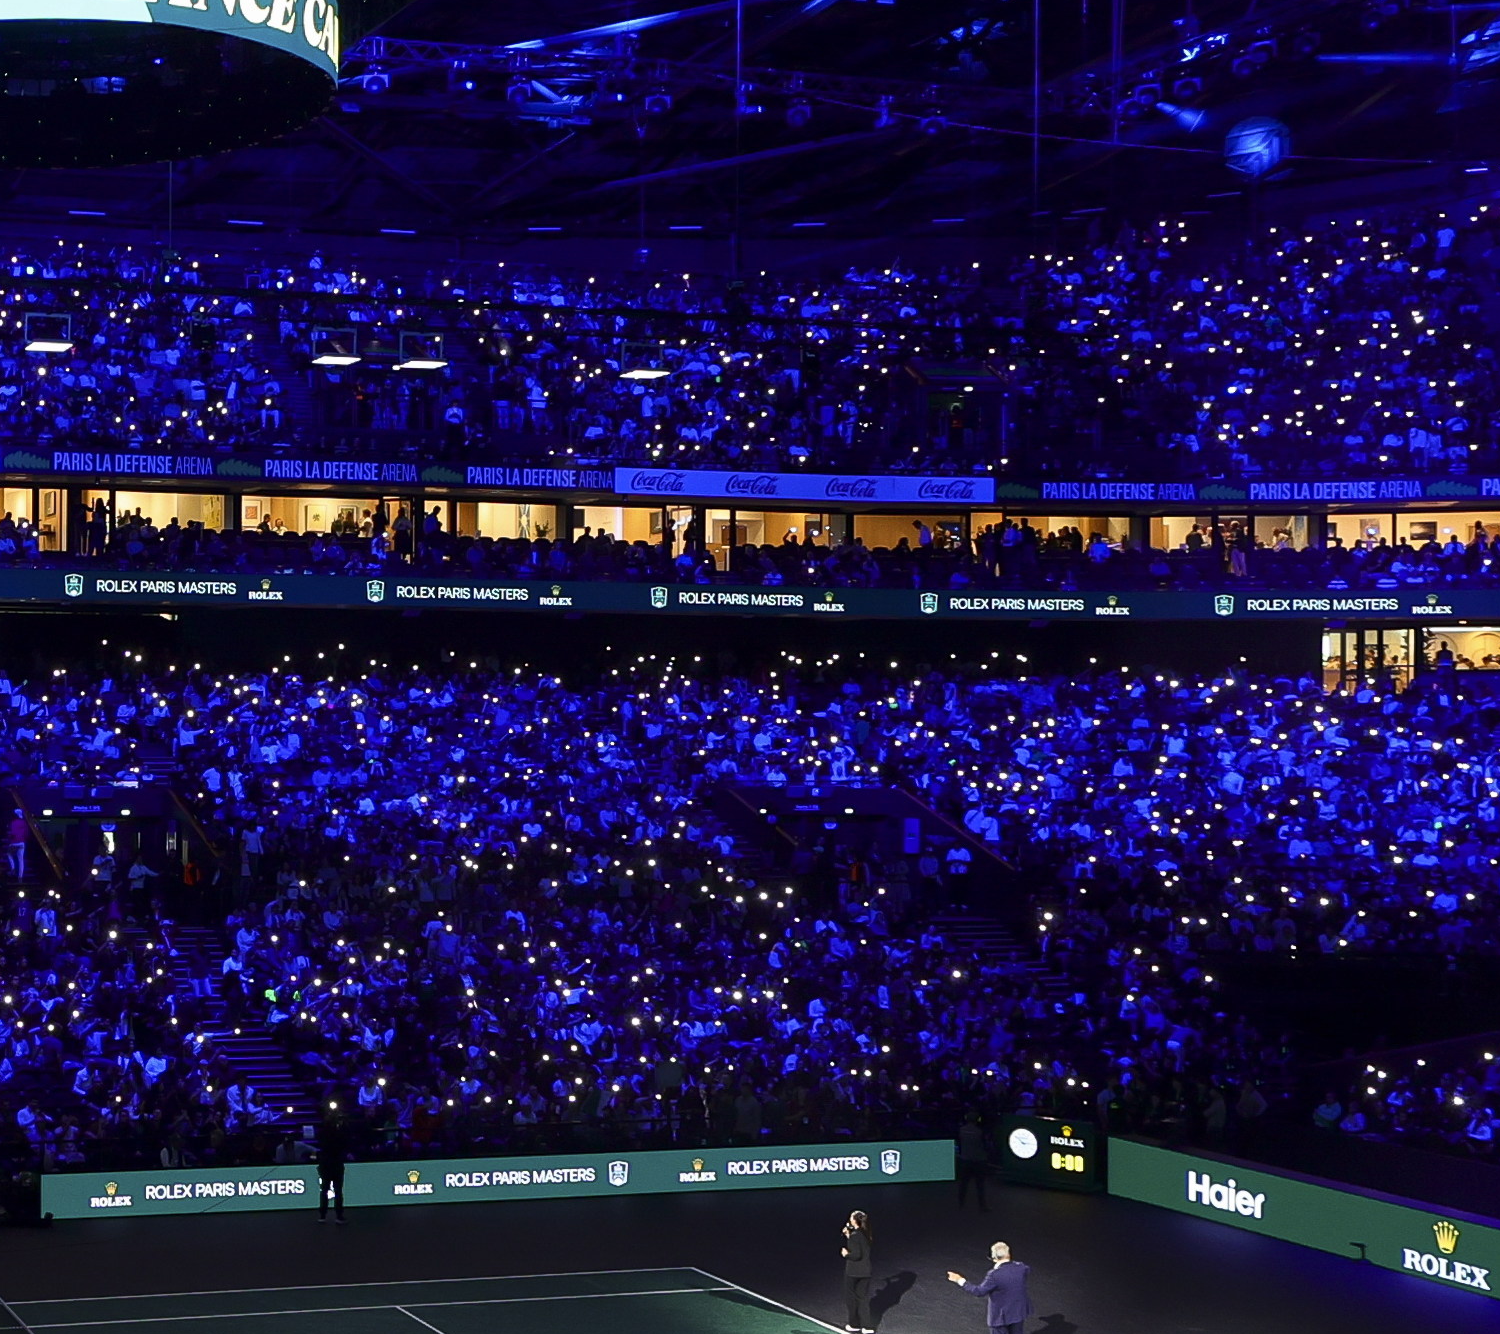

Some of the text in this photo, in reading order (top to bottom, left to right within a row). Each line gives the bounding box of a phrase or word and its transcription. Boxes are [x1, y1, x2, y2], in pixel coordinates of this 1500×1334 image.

[53, 451, 213, 475] PARIS LA DEFENSE ARENA
[467, 466, 613, 489] PARIS LA DEFENSE ARENA
[1250, 480, 1422, 500] PARIS LA DEFENSE ARENA
[96, 579, 237, 595] ROLEX PARIS MASTERS
[248, 591, 283, 600] ROLEX
[678, 591, 804, 606] ROLEX PARIS MASTERS
[813, 603, 845, 612] ROLEX
[1246, 598, 1399, 611] ROLEX PARIS MASTERS
[1411, 605, 1453, 614] ROLEX
[1051, 1136, 1084, 1148] ROLEX
[727, 1156, 869, 1175] ROLEX PARIS MASTERS
[445, 1167, 596, 1187] ROLEX PARIS MASTERS
[680, 1172, 716, 1182] ROLEX
[145, 1179, 305, 1199] ROLEX PARIS MASTERS
[395, 1182, 433, 1194] ROLEX
[1186, 1169, 1265, 1219] Haier
[91, 1196, 131, 1207] ROLEX
[1404, 1247, 1490, 1291] ROLEX
